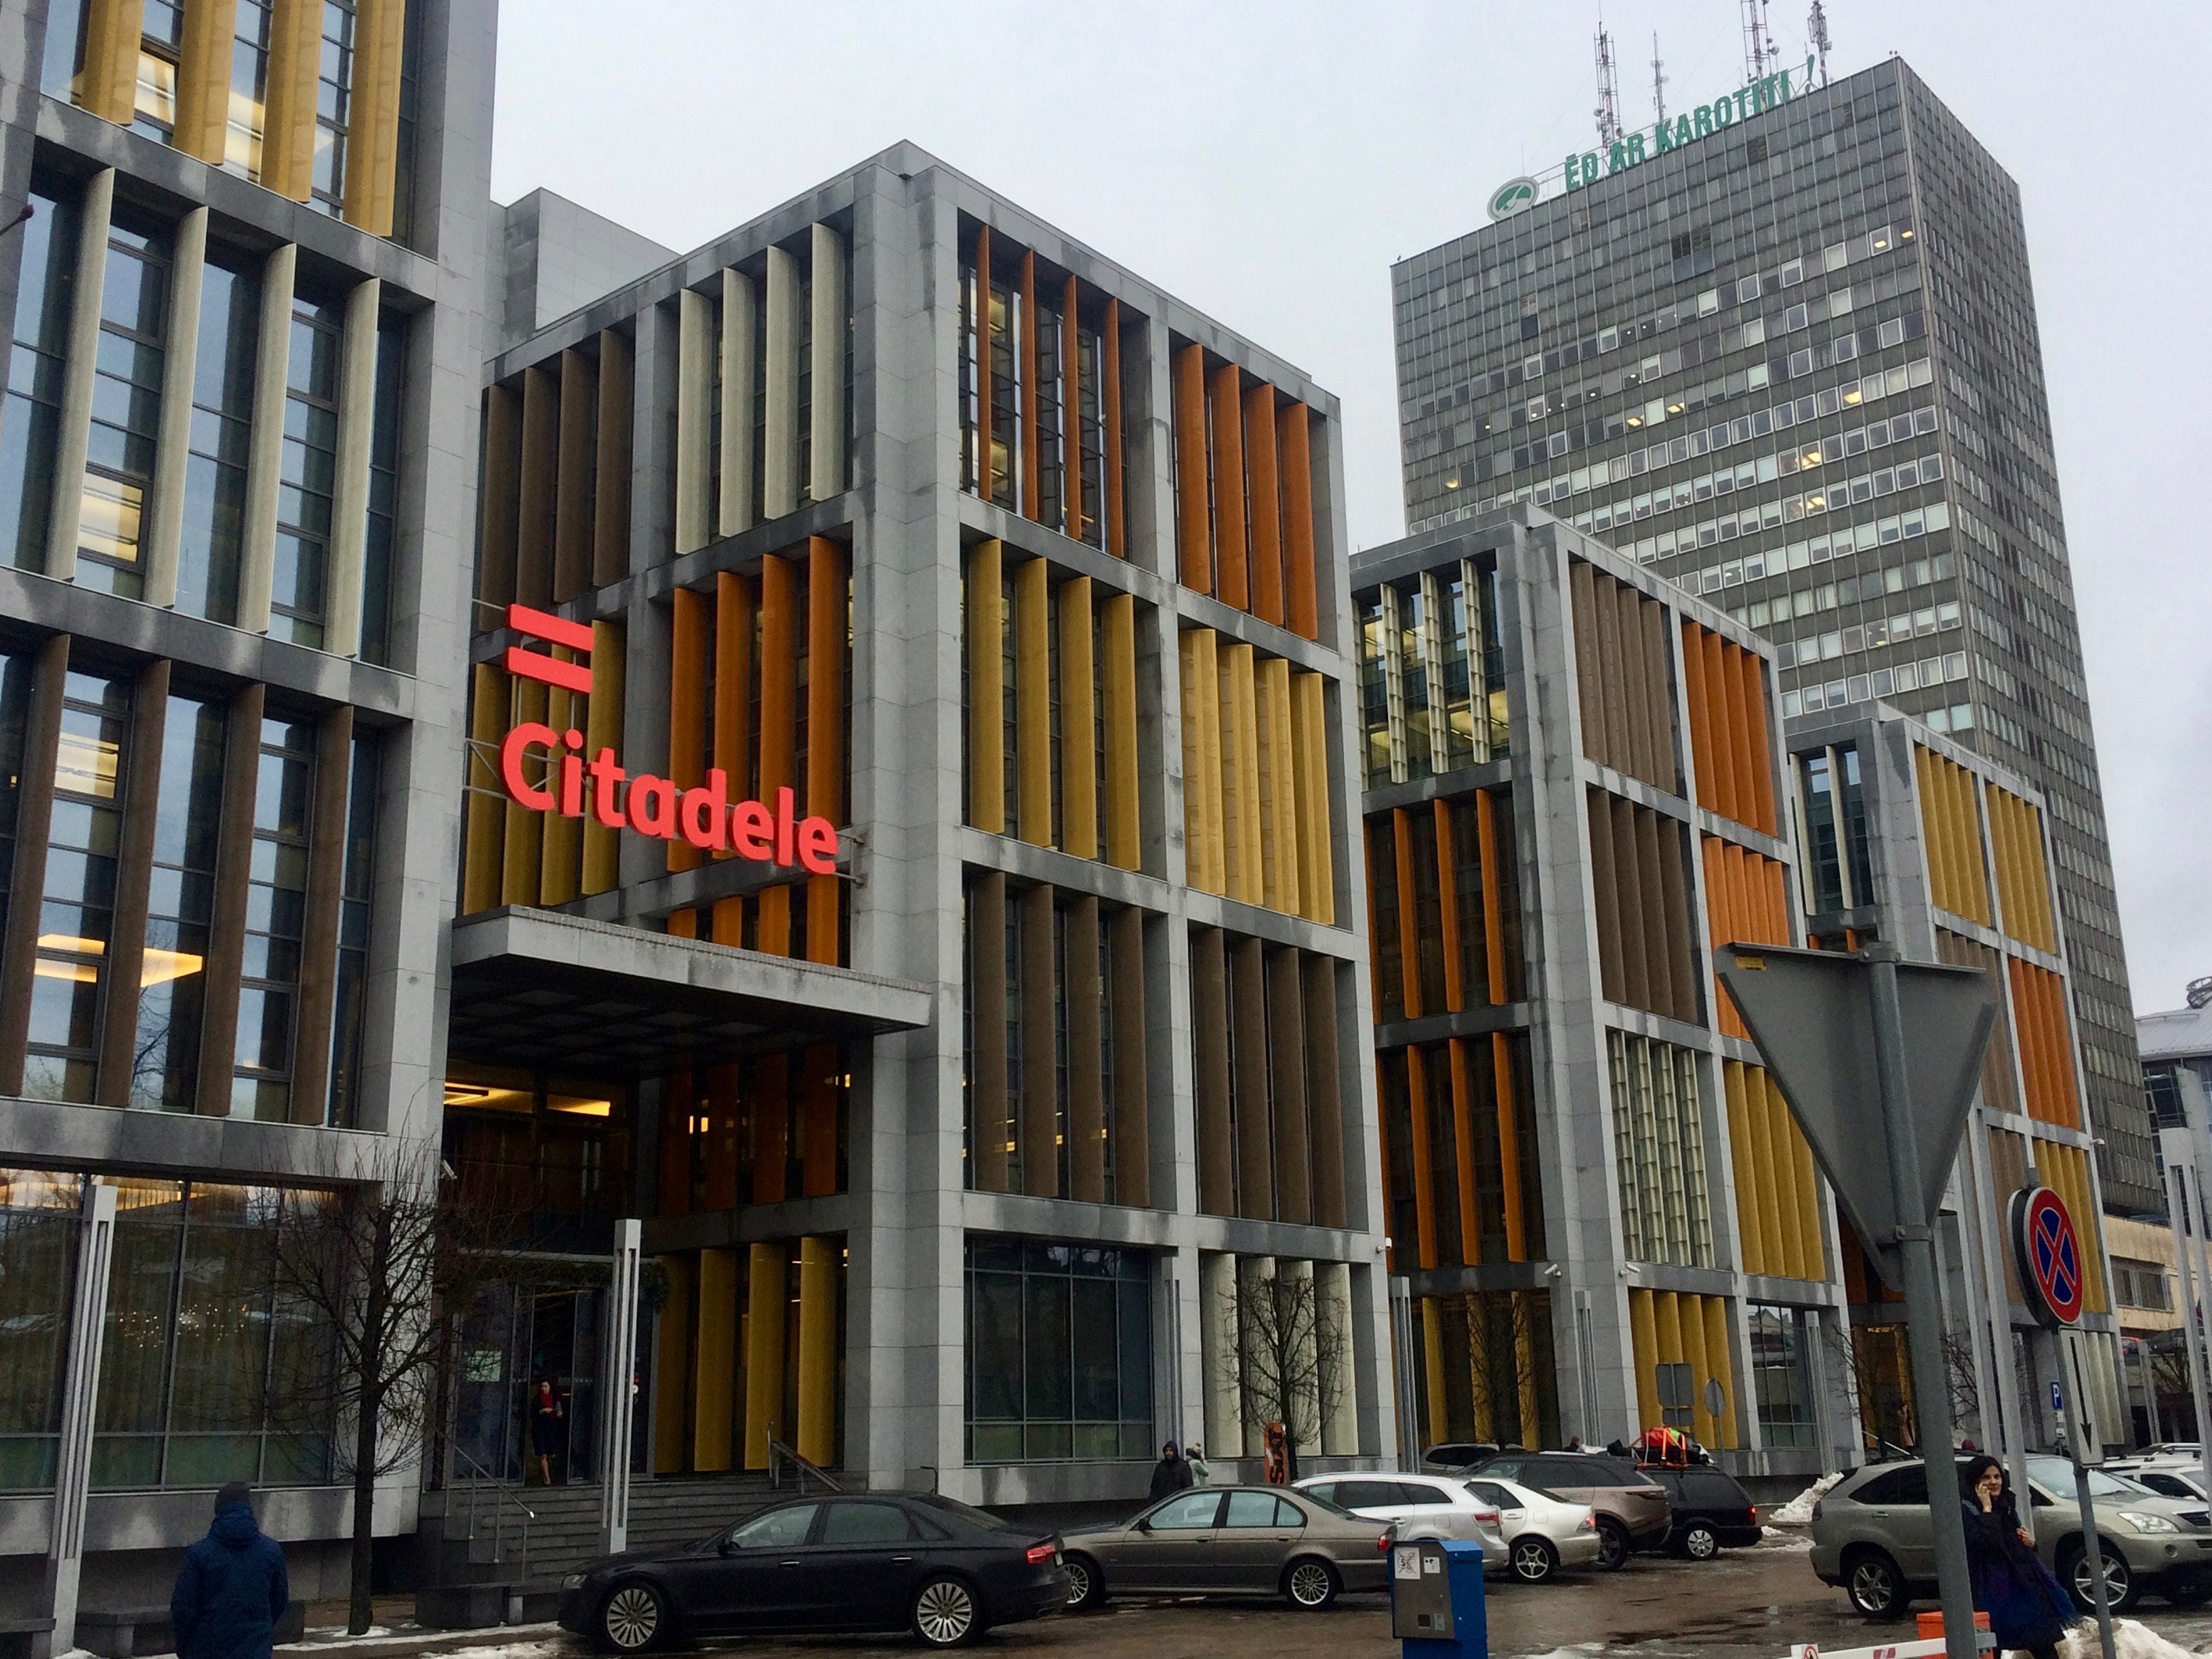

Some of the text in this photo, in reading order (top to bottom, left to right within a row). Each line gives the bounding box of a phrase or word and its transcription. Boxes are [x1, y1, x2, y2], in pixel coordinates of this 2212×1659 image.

[1610, 133, 1645, 175] AR
[499, 722, 838, 874] Citadele
[2052, 1384, 2060, 1406] P
